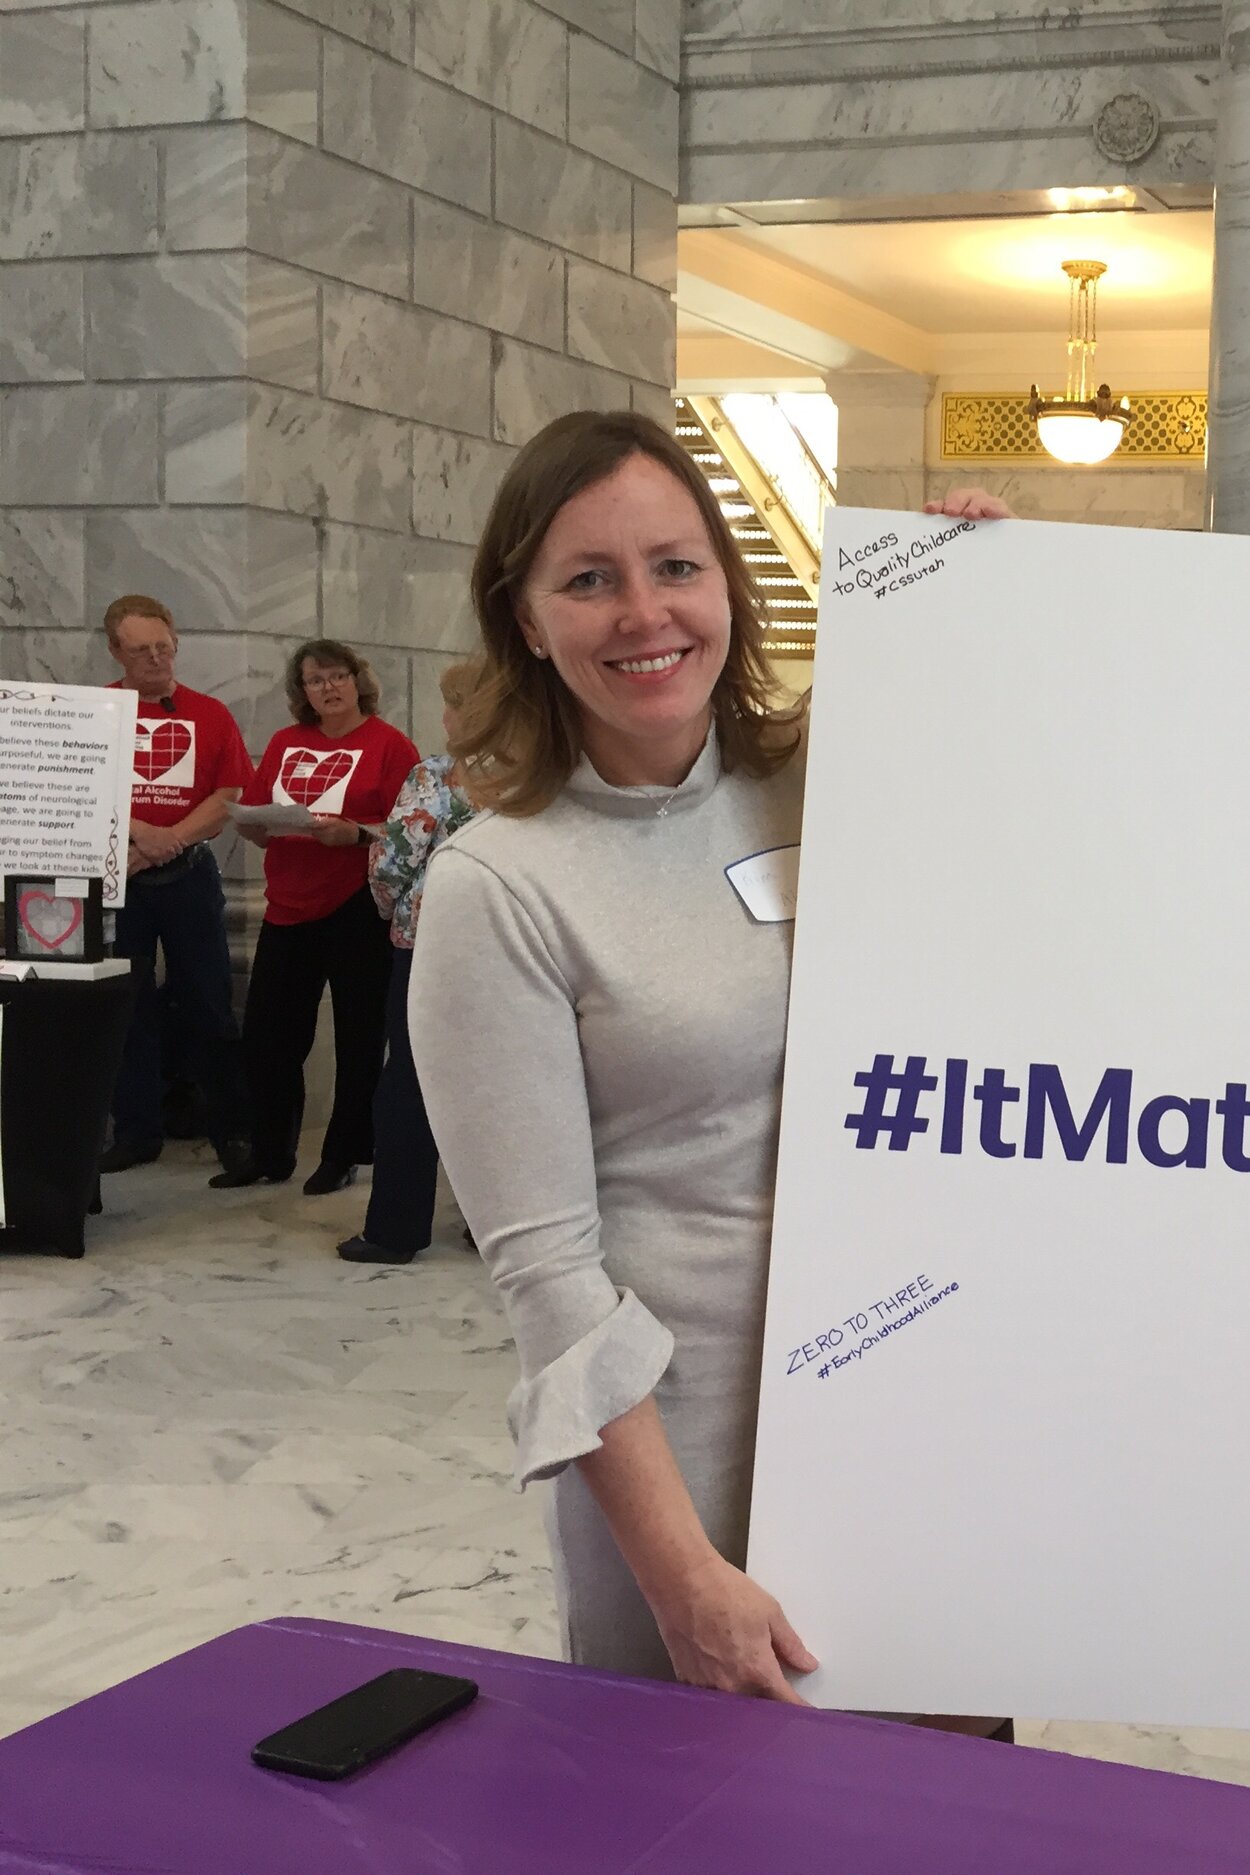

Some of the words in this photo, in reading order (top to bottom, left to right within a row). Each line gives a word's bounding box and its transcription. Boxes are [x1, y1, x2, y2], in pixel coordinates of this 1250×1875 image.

[838, 532, 899, 571] Access
[832, 581, 854, 596] to
[856, 552, 910, 588] Quality
[910, 521, 976, 558] Childcare
[12, 706, 41, 715] beliefs
[44, 709, 76, 717] dictate
[35, 739, 60, 747] these
[62, 740, 108, 750] behaviors
[81, 755, 106, 764] going
[12, 781, 44, 789] believe
[47, 783, 72, 791] these
[145, 786, 180, 795] Alcohol
[41, 796, 97, 806] neurological
[153, 796, 190, 806] Disorder
[56, 809, 81, 818] going
[0, 837, 20, 845] ging
[42, 838, 67, 846] belief
[21, 850, 63, 858] symptom
[66, 852, 103, 862] changes
[20, 862, 38, 870] look
[786, 1329, 843, 1375] ZERO
[843, 1313, 868, 1334] TO
[868, 1274, 934, 1319] THREE
